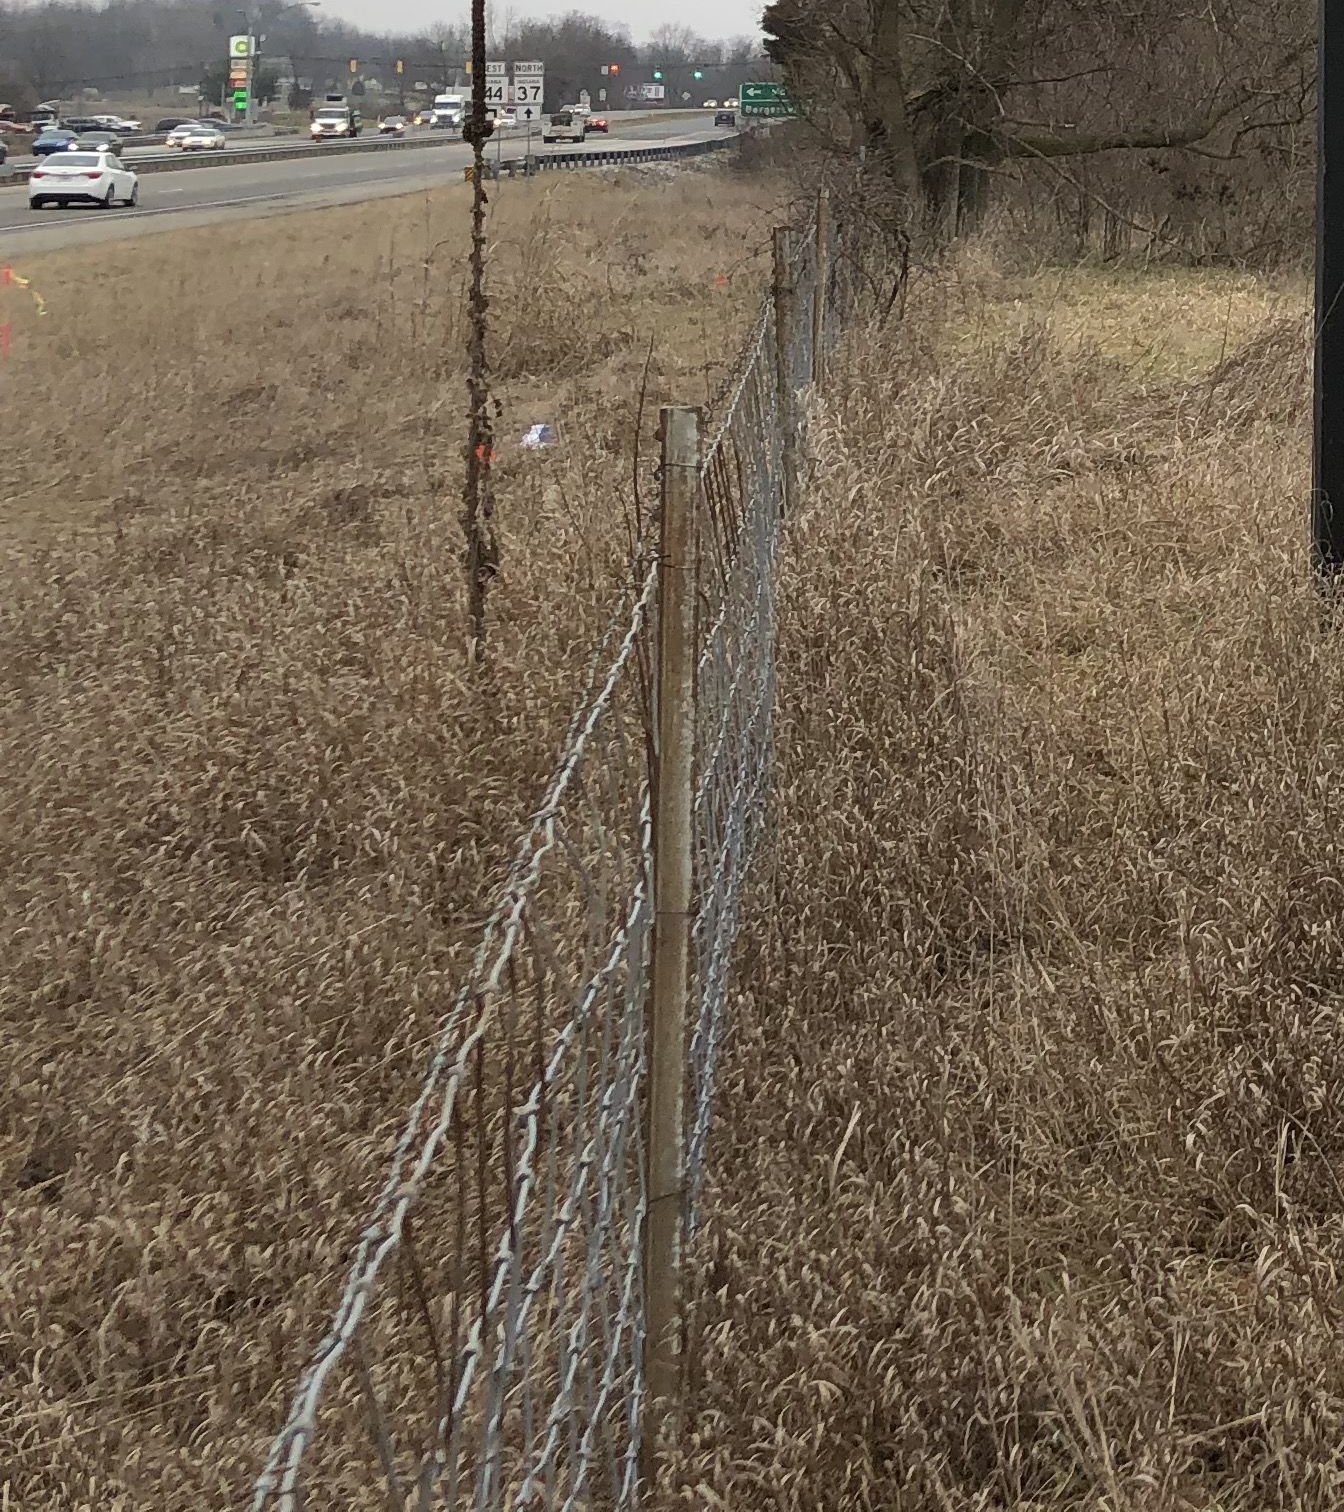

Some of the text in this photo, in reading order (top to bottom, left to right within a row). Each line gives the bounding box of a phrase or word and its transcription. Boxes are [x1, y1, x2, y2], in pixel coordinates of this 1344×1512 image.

[486, 64, 503, 73] EST
[515, 64, 543, 73] NORTH
[517, 86, 541, 101] 37
